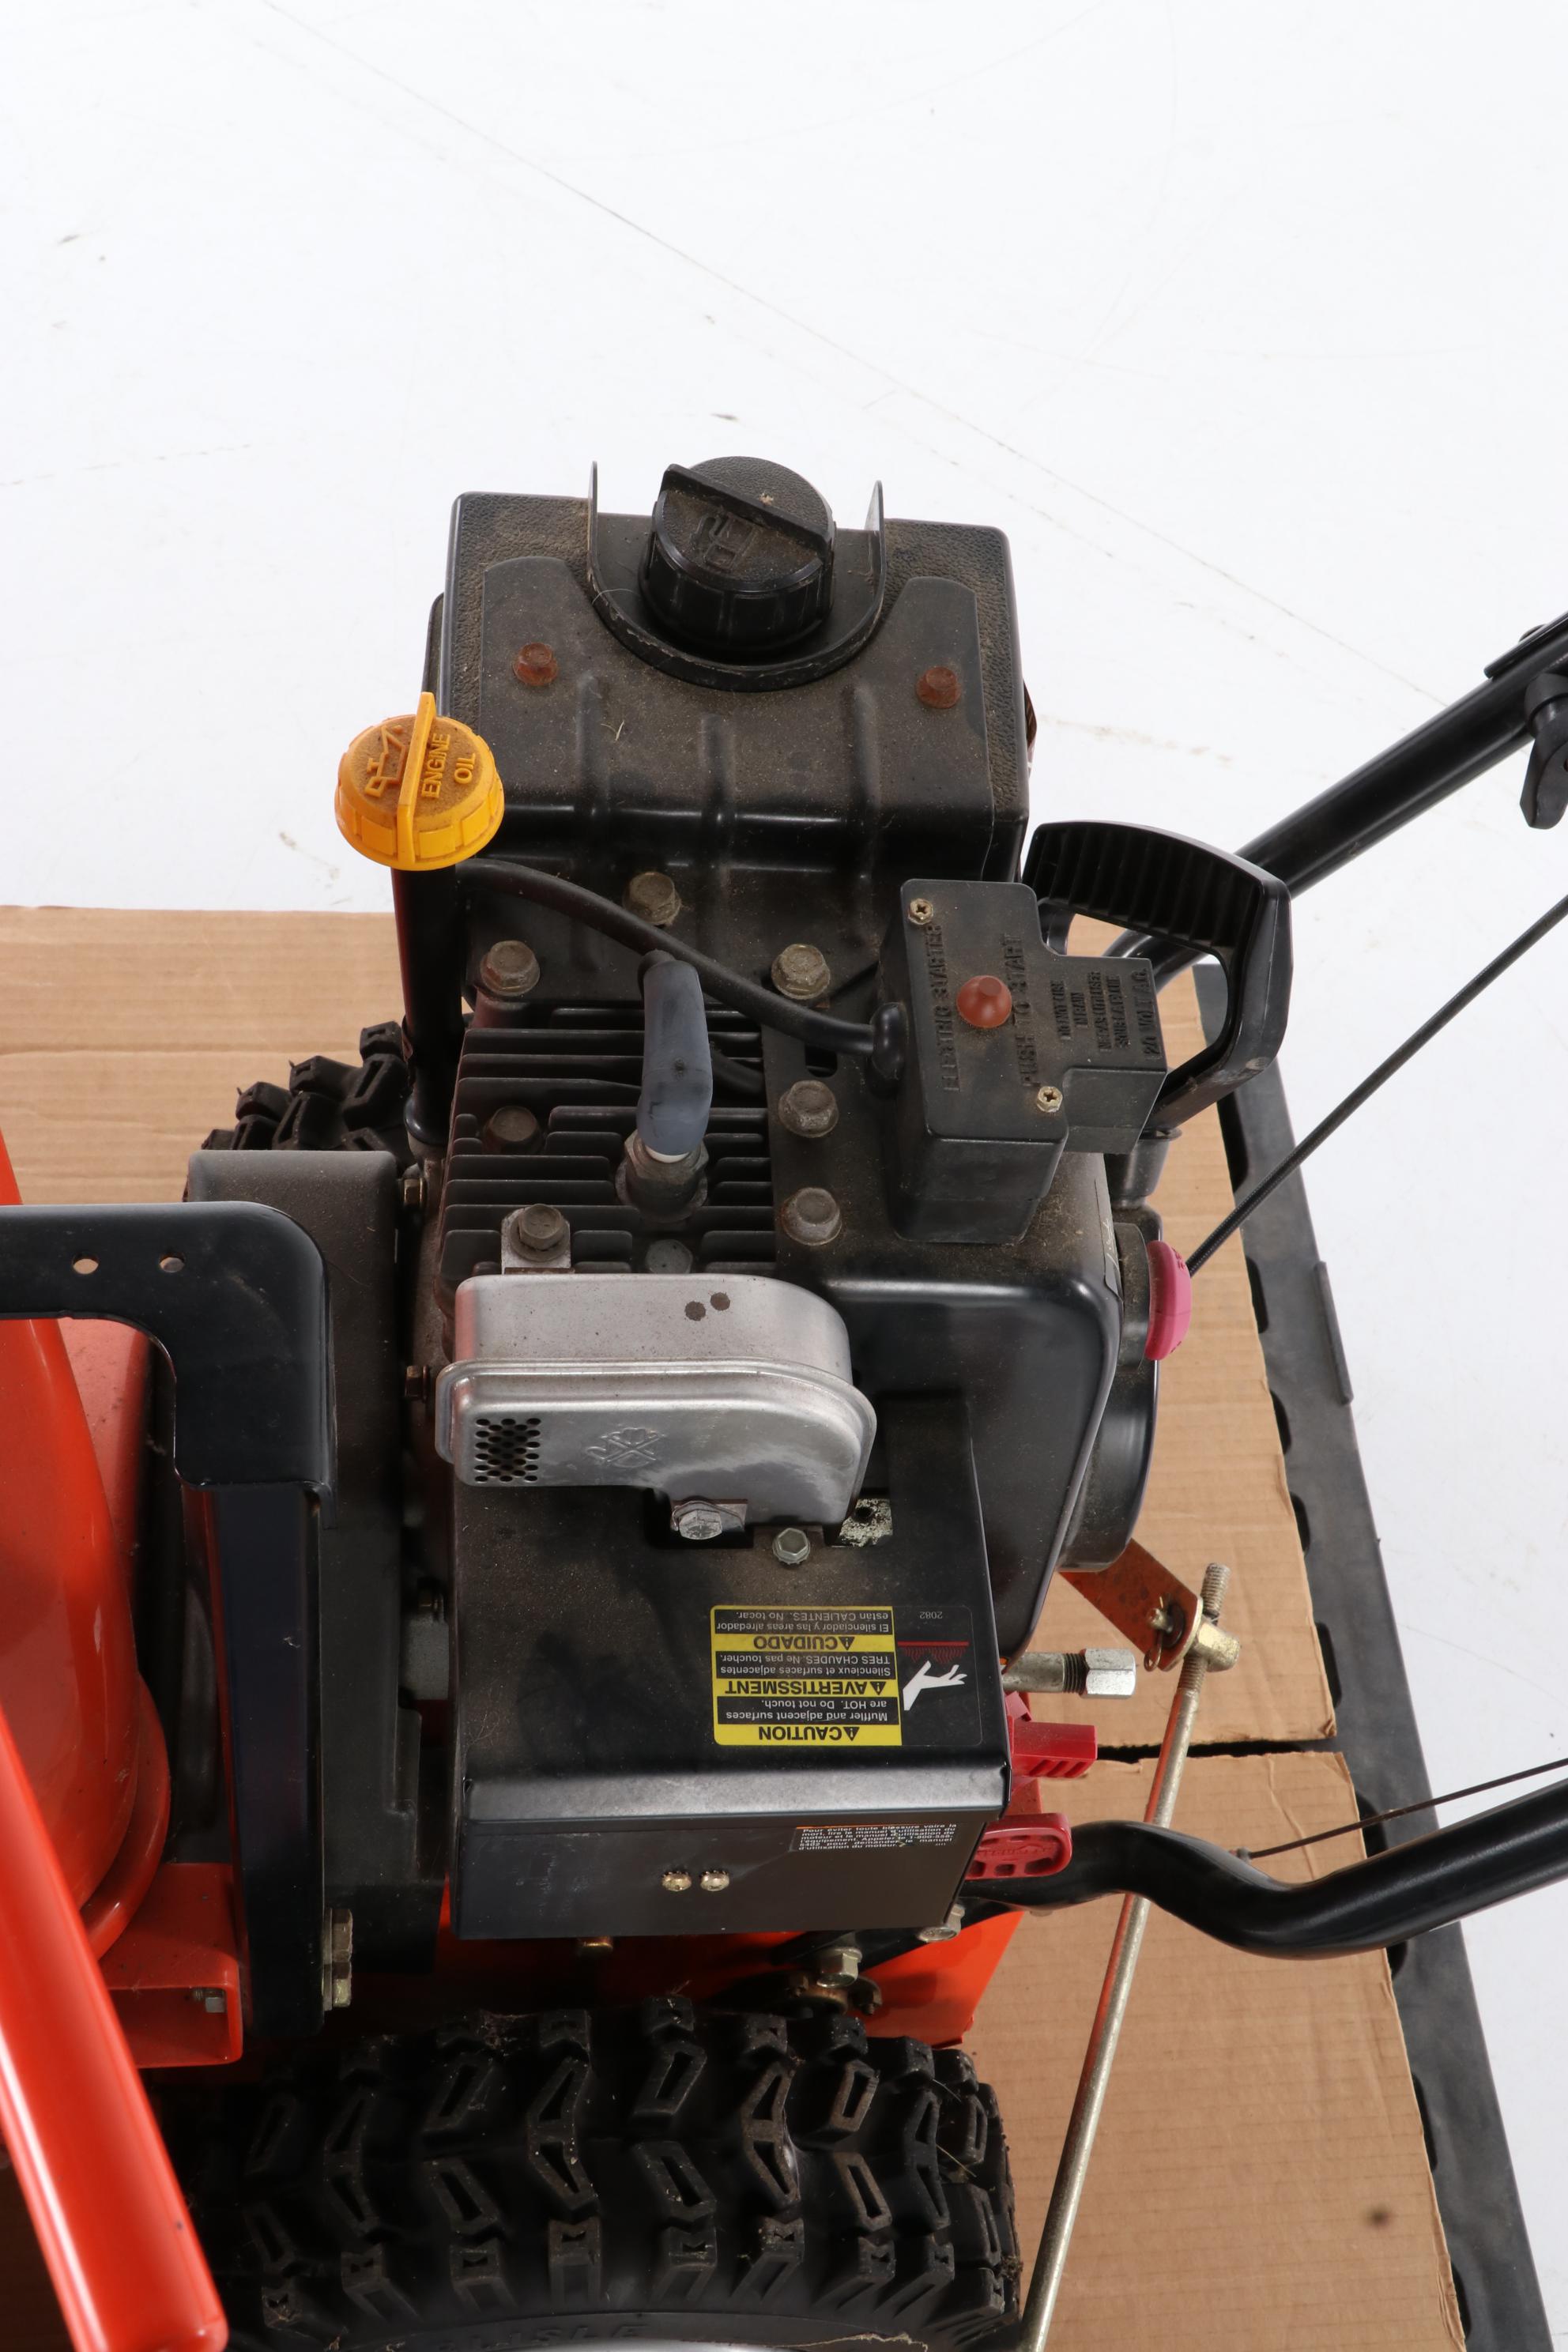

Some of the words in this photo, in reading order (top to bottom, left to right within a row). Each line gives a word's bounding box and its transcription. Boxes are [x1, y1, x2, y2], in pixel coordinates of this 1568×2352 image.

[421, 733, 450, 798] ENGINE
[454, 753, 476, 783] OIL
[925, 925, 949, 999] STARTER
[1003, 933, 1027, 992] START
[1012, 1003, 1031, 1026] TO
[935, 1005, 960, 1092] ELECTRIC
[1016, 1037, 1040, 1087] PUSH
[736, 1612, 766, 1621] tocar.
[768, 1612, 783, 1621] No
[790, 1612, 856, 1622] CALIENTES.
[717, 1623, 763, 1632] alredador
[797, 1623, 811, 1632] las
[815, 1621, 820, 1630] y
[822, 1623, 876, 1632] silenciador
[754, 1637, 839, 1649] CUIDADO
[720, 1656, 762, 1664] toucher.
[766, 1653, 783, 1662] pas
[786, 1656, 800, 1664] Ne
[803, 1656, 858, 1665] CHAUDES.
[861, 1656, 890, 1664] TRES
[721, 1665, 776, 1676] adjacentes
[778, 1667, 822, 1676] surfaces
[838, 1666, 891, 1676] Silencieux
[725, 1681, 867, 1694] AVERTISSMENT
[761, 1700, 795, 1709] touch.
[820, 1700, 835, 1709] Do
[841, 1700, 867, 1709] HOT.
[870, 1700, 887, 1709] are
[726, 1712, 773, 1721] surfaces
[777, 1710, 823, 1721] adjacent
[827, 1711, 846, 1721] and
[850, 1711, 888, 1721] Muffler
[759, 1726, 842, 1740] CAUTION
